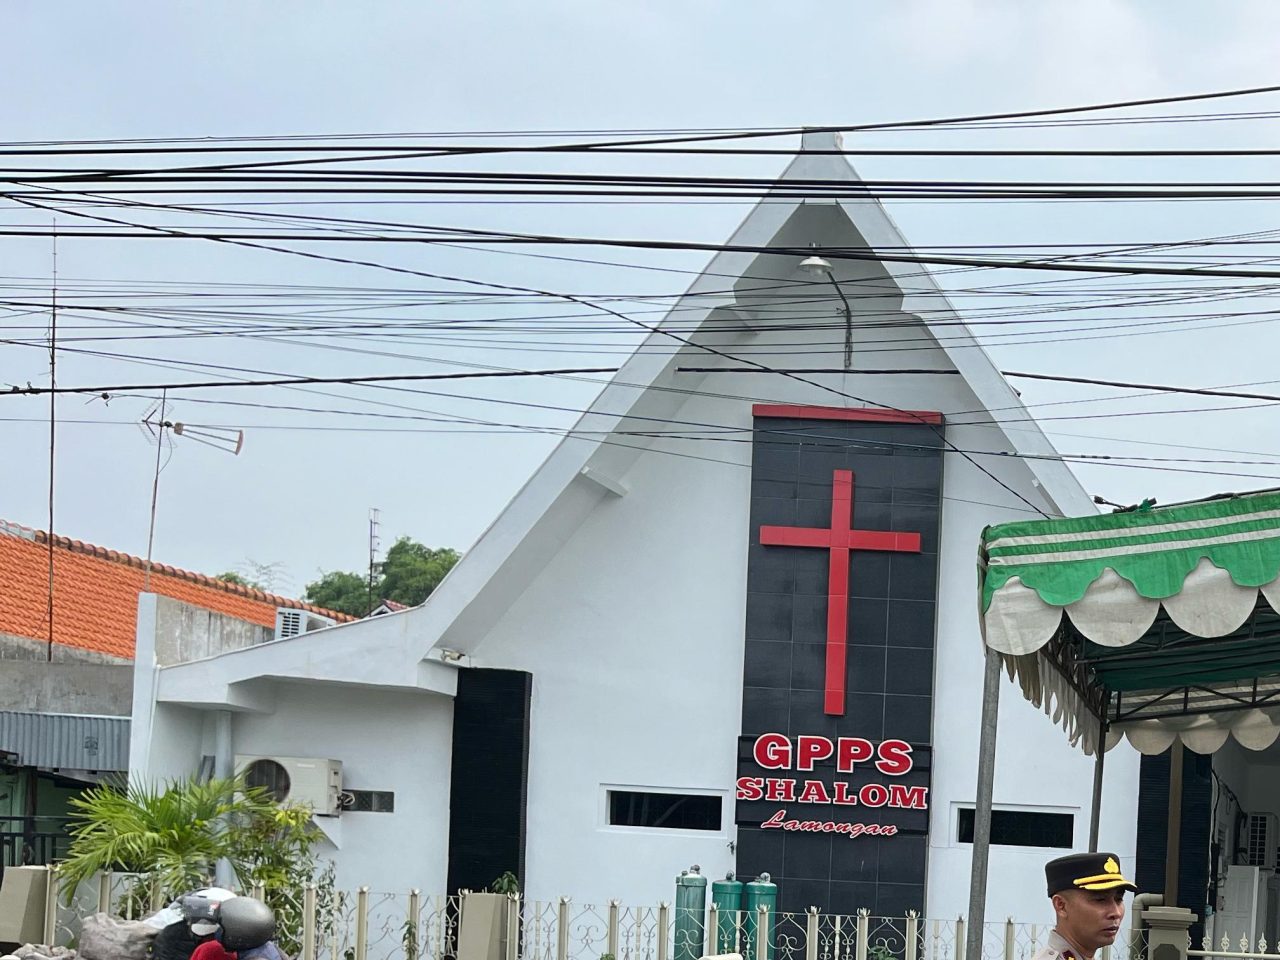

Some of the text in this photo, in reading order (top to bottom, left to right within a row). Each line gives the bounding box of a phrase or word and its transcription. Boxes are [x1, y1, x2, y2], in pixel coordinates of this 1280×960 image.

[753, 733, 913, 776] GPPS
[736, 776, 928, 809] SHALOM
[761, 809, 898, 838] Lamongan
